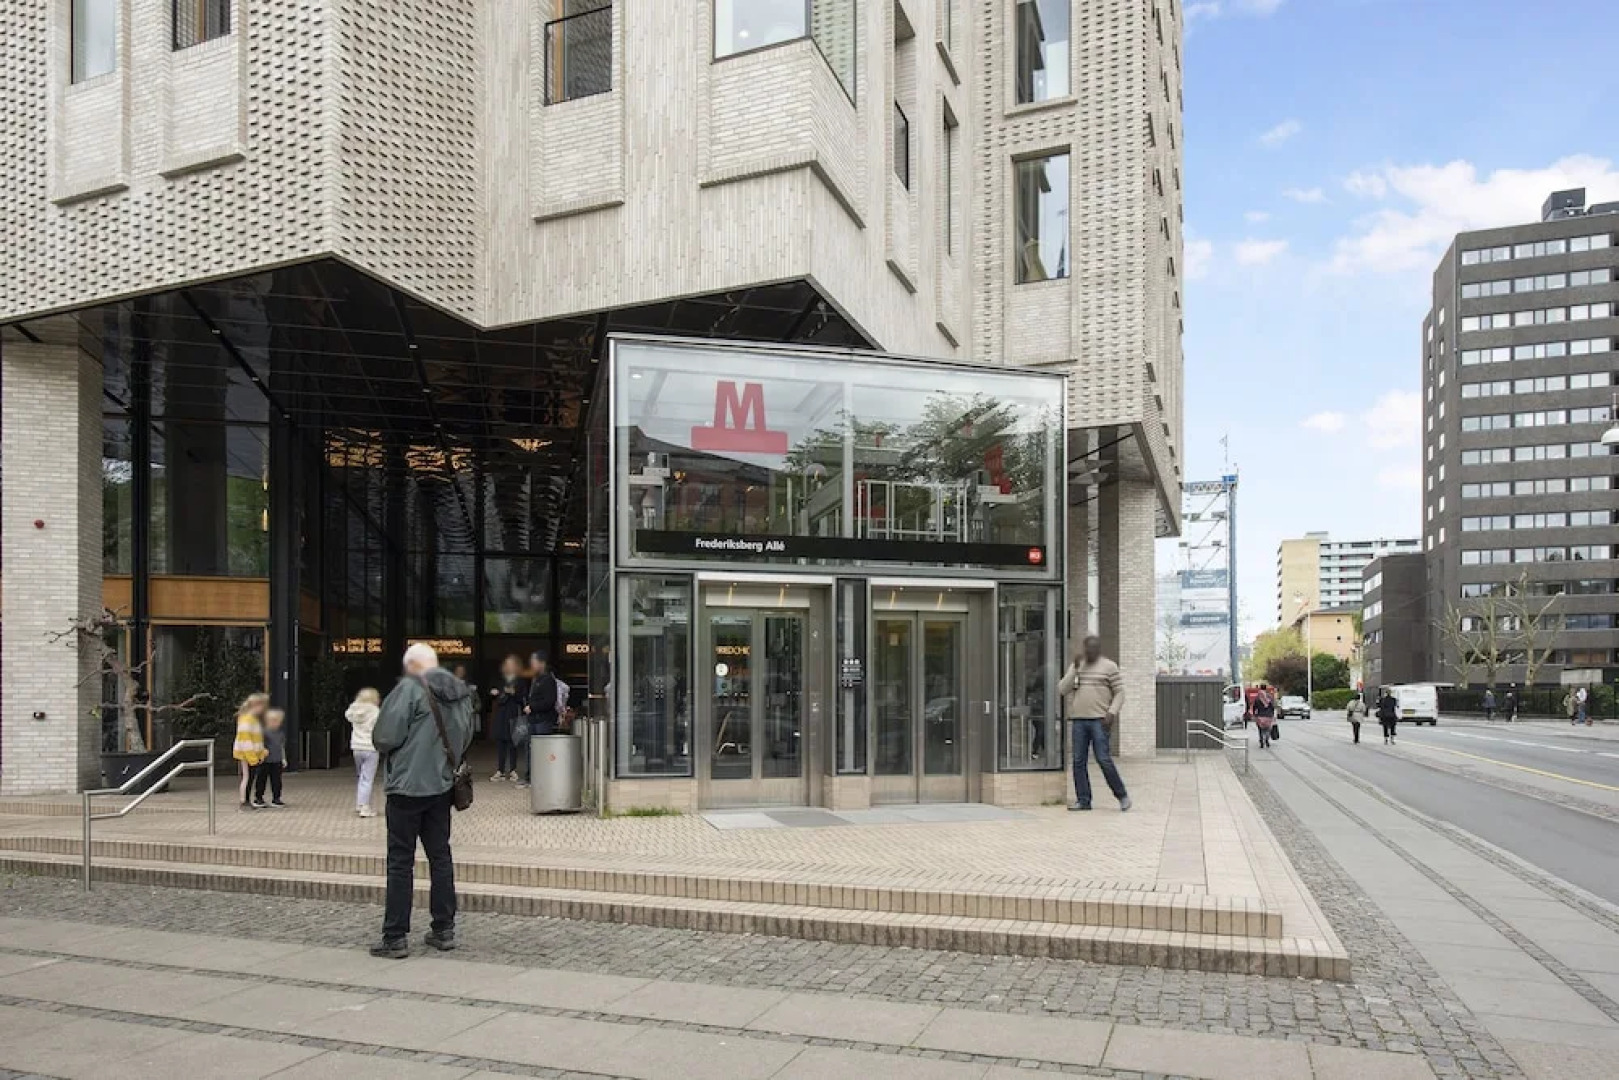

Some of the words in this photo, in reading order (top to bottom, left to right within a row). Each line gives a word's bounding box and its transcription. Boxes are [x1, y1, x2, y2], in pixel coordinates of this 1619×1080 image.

[714, 380, 767, 431] M
[695, 538, 764, 553] Frederiksberg
[765, 540, 786, 551] Allé
